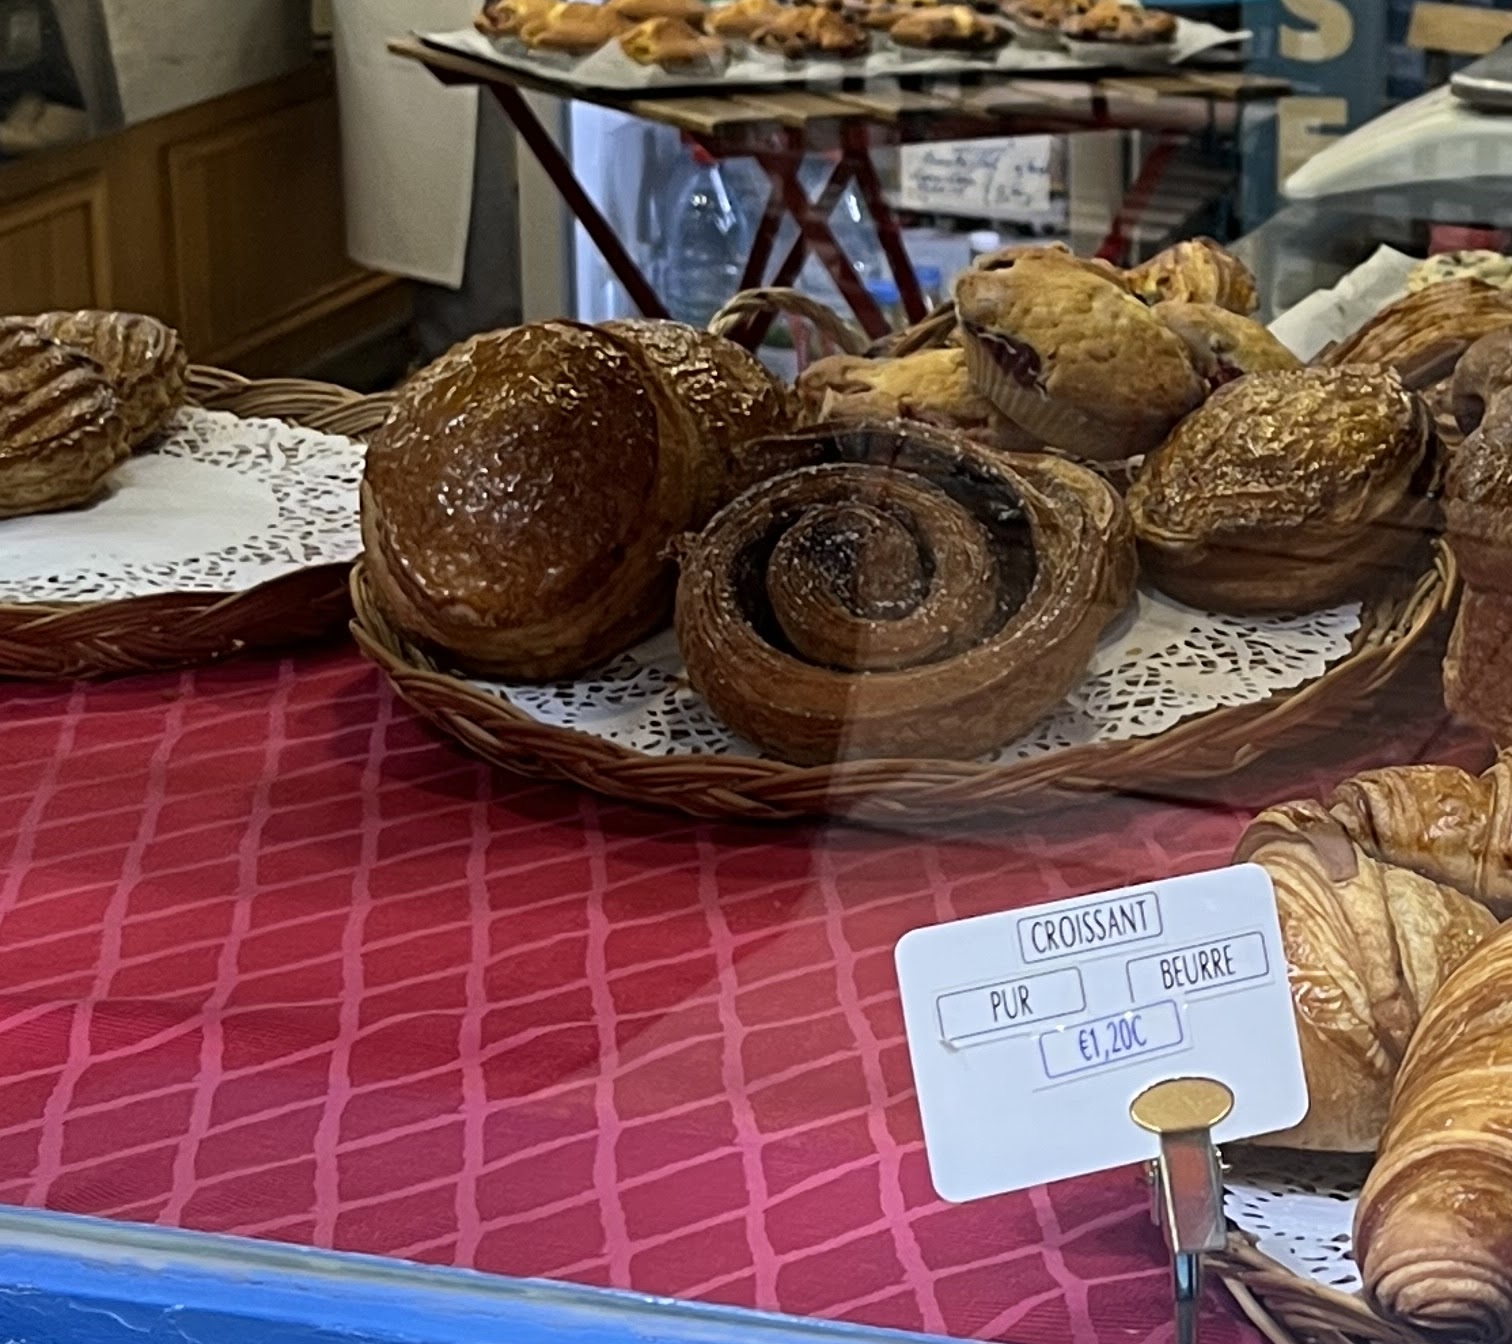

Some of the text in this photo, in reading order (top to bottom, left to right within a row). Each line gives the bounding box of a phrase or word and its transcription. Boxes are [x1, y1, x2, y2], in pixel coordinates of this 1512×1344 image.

[1030, 899, 1148, 955] CROISSANT
[989, 944, 1237, 1023] PUR BEURRE
